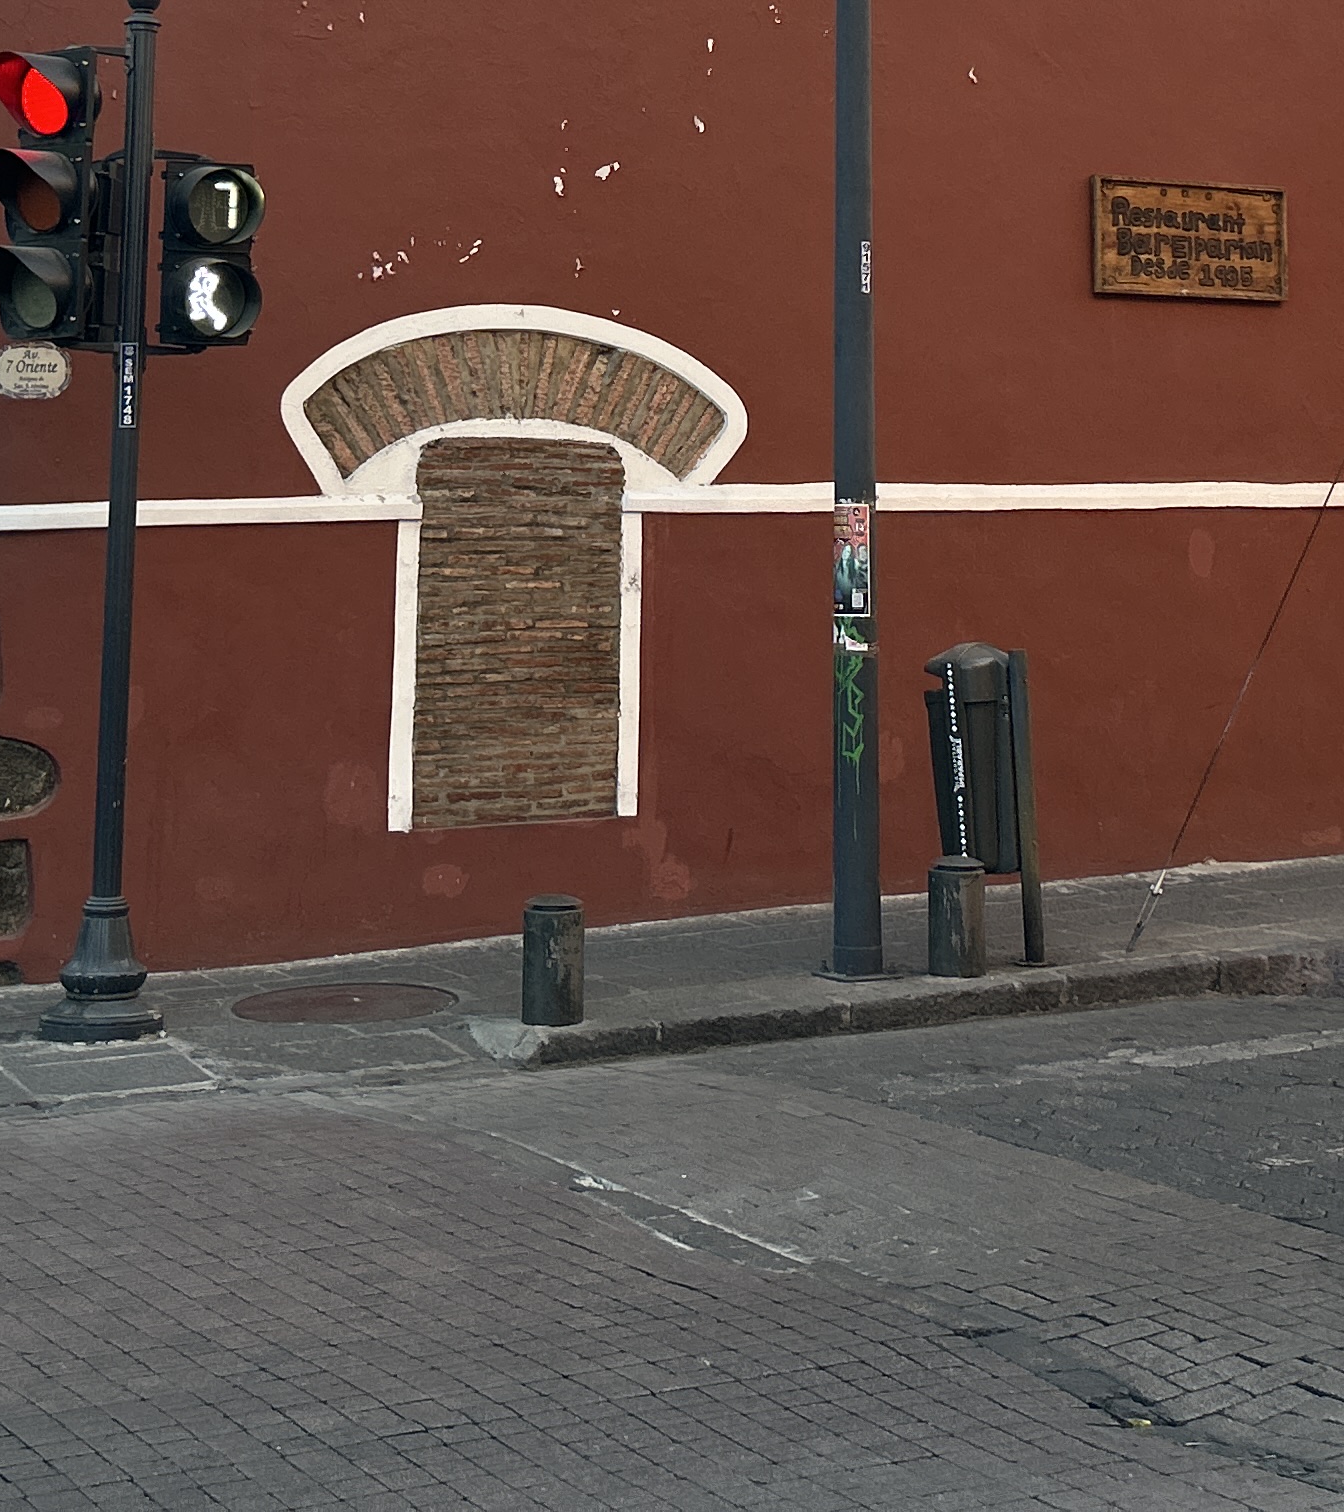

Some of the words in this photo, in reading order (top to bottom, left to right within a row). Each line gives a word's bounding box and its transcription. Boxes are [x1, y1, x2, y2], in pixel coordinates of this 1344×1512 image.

[1111, 196, 1246, 235] Restaurant
[1130, 255, 1191, 281] Desde
[5, 359, 14, 374] 7
[16, 359, 58, 374] Oriente
[22, 349, 40, 360] Av.
[123, 358, 134, 384] SEM
[122, 385, 133, 425] 1748
